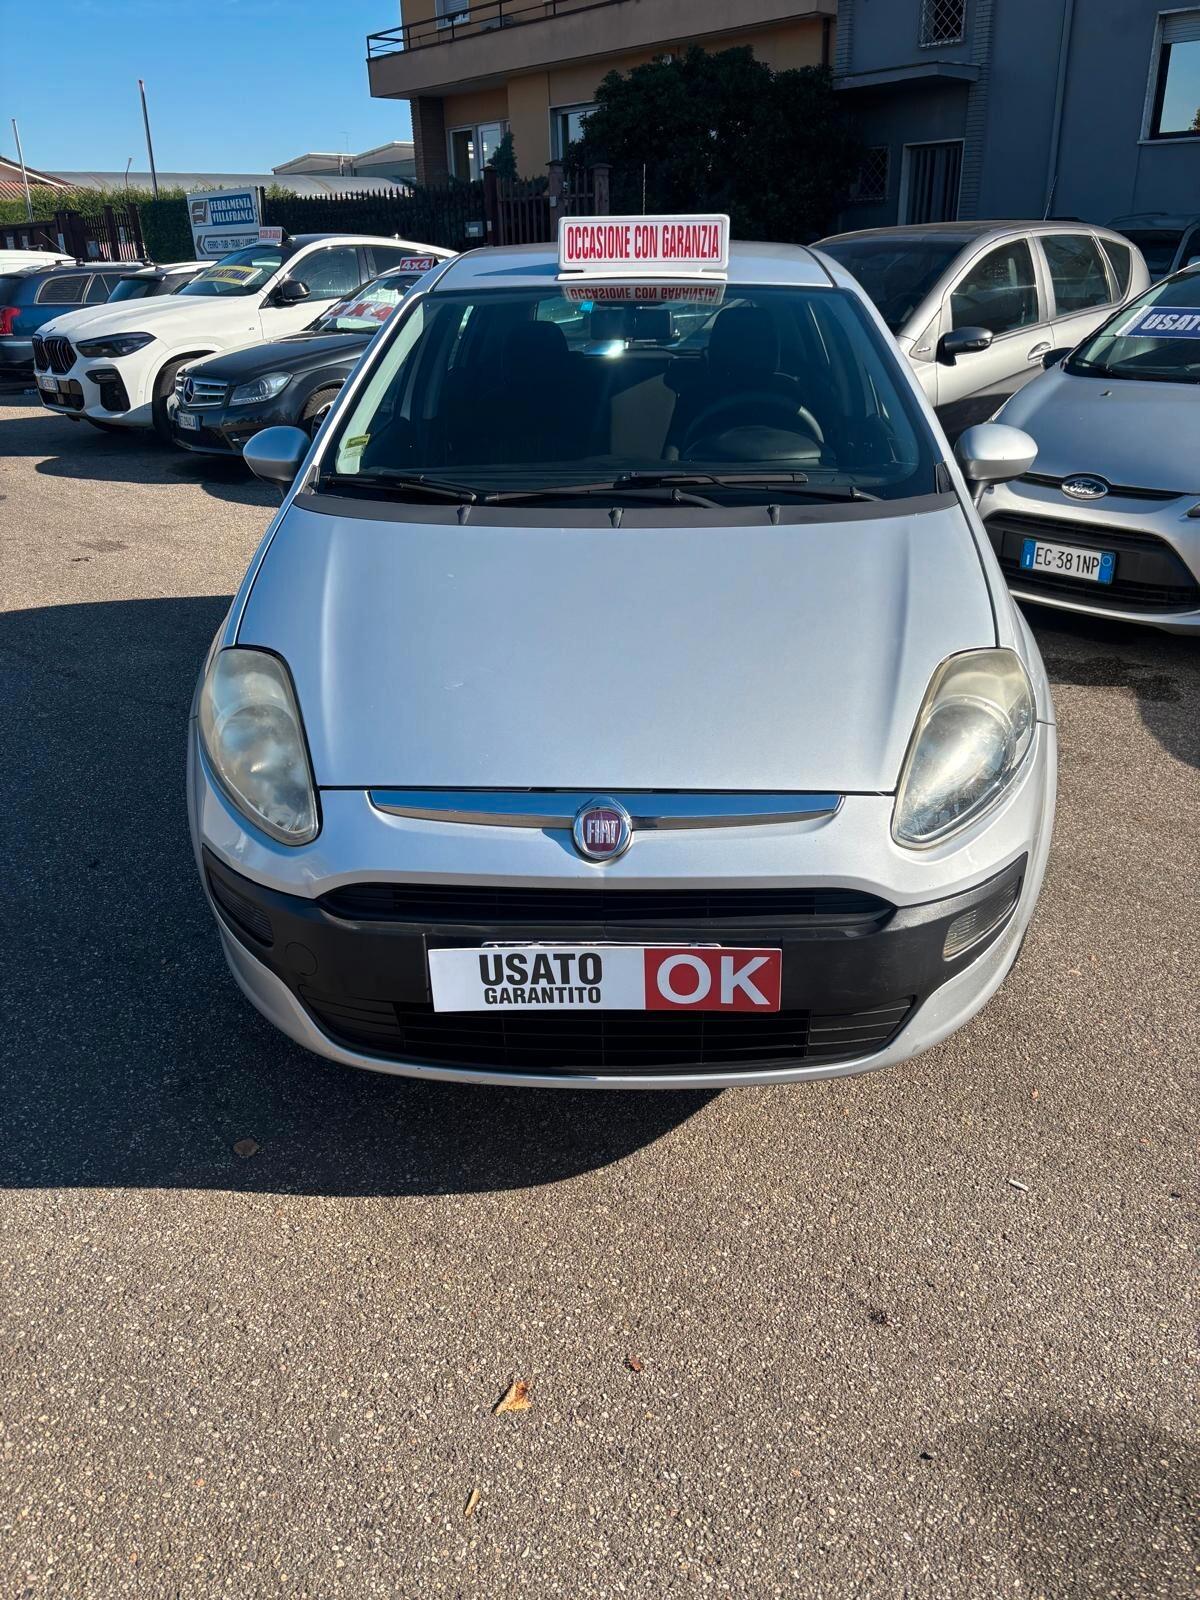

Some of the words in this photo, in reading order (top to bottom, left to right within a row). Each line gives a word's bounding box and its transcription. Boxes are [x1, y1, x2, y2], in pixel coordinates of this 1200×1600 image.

[210, 198, 252, 211] FERRAMENTA
[212, 209, 254, 223] VILLAFRANCA
[567, 226, 630, 259] OCCASIONE
[634, 225, 658, 258] CON
[662, 225, 719, 258] GARANZIA
[1141, 314, 1200, 331] USAT
[586, 819, 619, 844] FIAT
[479, 953, 603, 985] USATO
[656, 954, 771, 1005] OK
[484, 986, 601, 1005] GARANTITO
